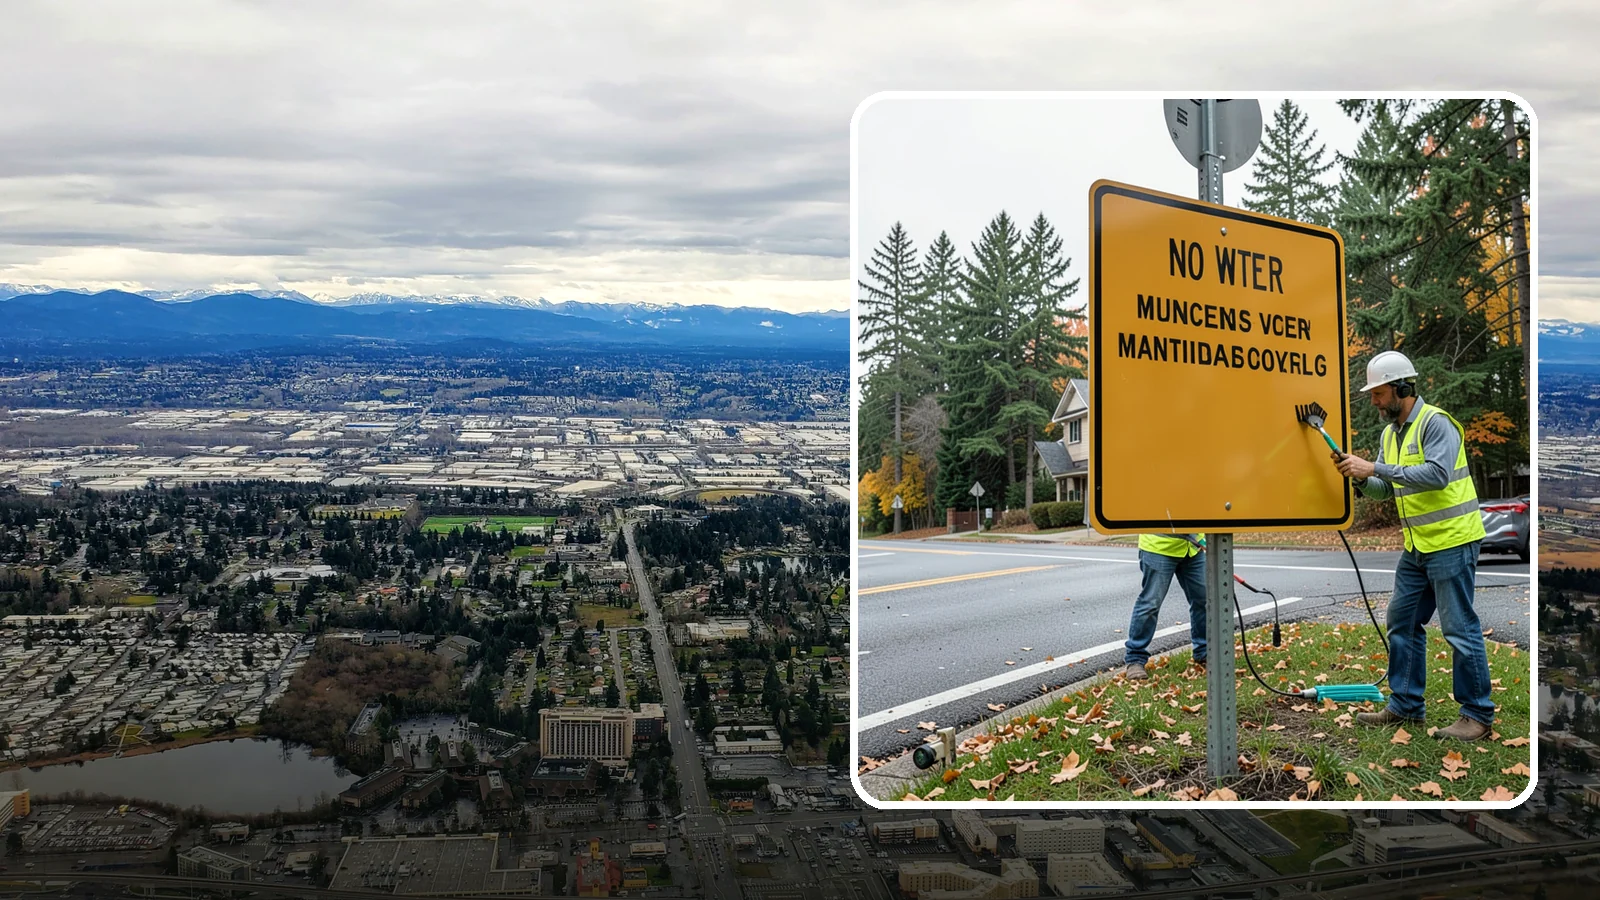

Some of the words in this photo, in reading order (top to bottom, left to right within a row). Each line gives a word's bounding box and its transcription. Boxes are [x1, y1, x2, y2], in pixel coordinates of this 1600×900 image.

[1169, 237, 1204, 281] NO
[1215, 245, 1284, 295] WTER
[1137, 294, 1252, 333] MUNCENS
